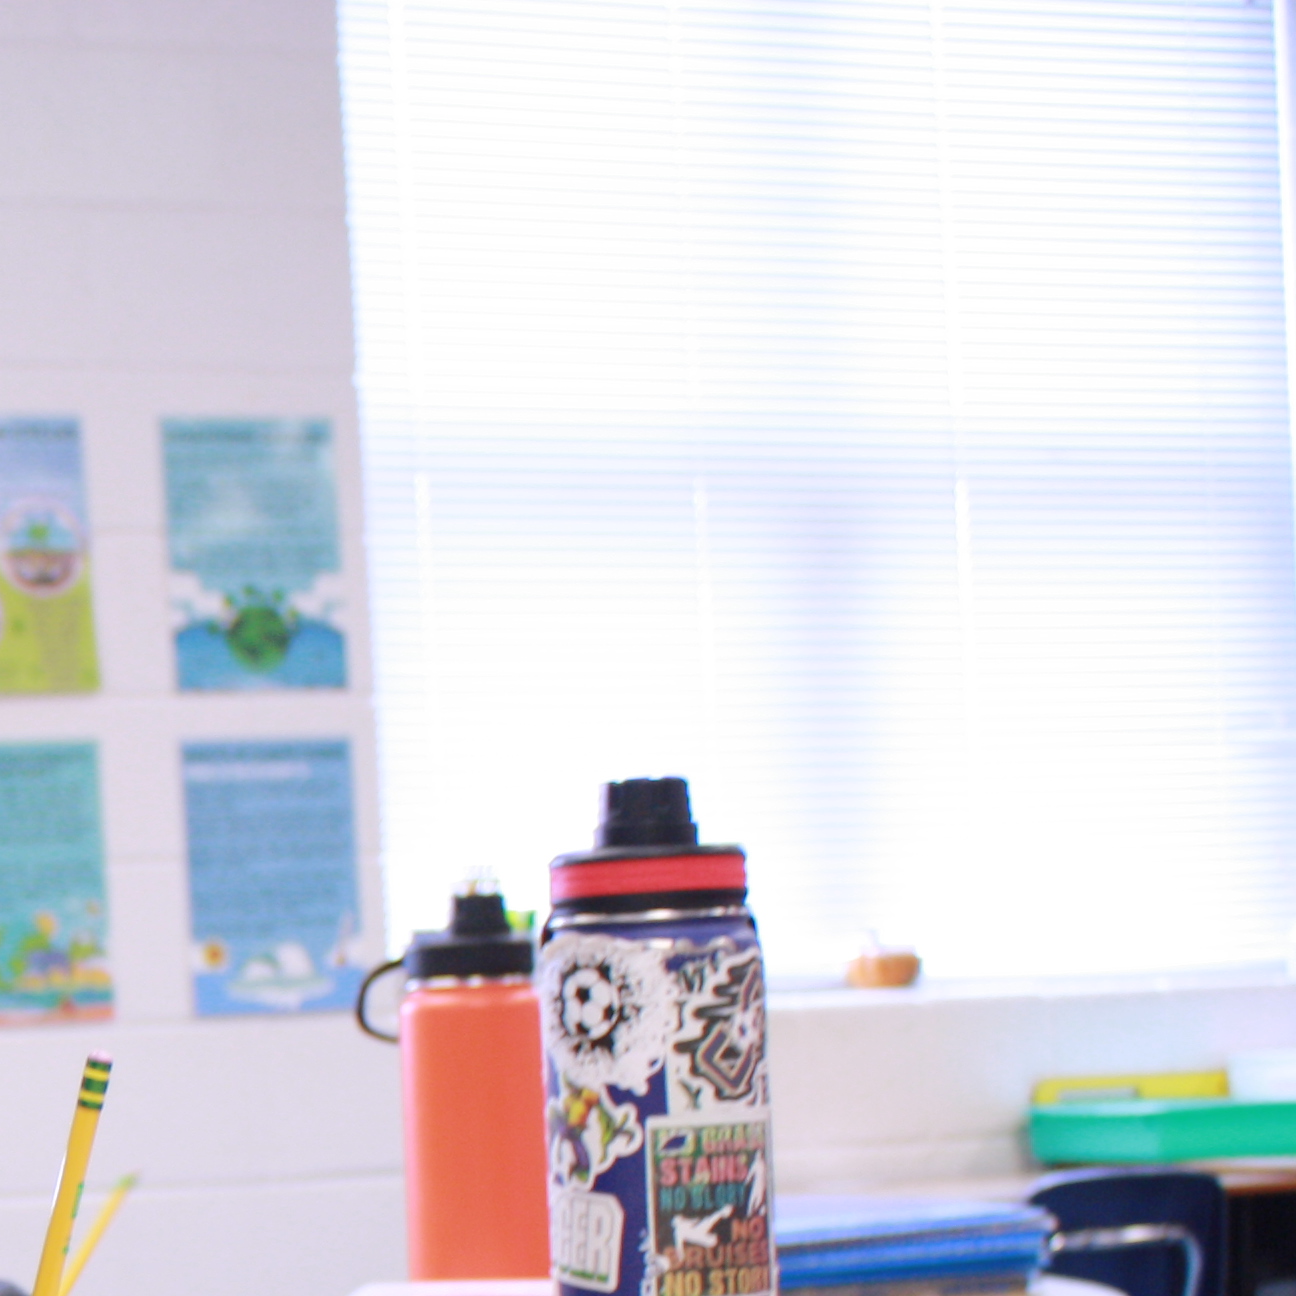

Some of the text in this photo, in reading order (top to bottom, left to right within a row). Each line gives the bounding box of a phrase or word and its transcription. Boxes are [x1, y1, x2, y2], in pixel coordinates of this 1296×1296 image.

[660, 1153, 749, 1186] STAINS
[660, 1186, 687, 1212] NO
[731, 1216, 765, 1242] NO
[663, 1239, 770, 1272] BRUISES
